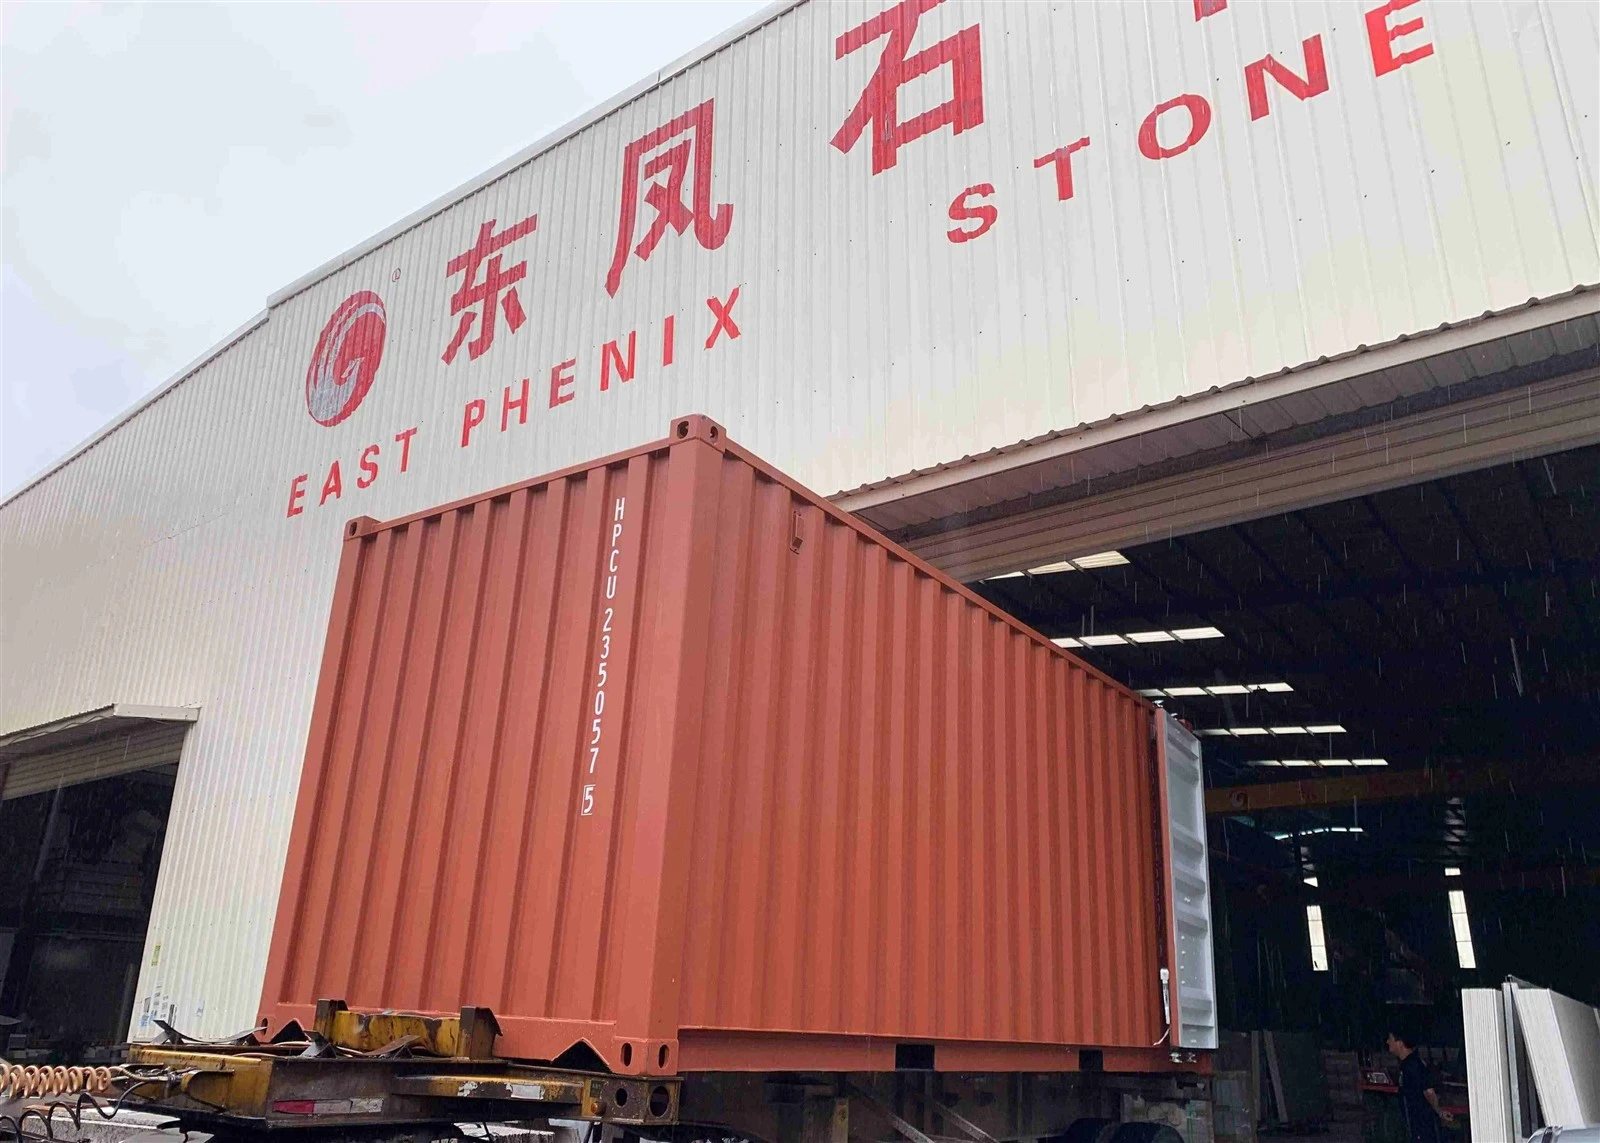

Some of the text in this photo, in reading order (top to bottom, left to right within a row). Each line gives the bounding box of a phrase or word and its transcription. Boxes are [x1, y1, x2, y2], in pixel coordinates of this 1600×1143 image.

[286, 0, 1435, 518] EAST PHENIX STONE
[441, 0, 1228, 364] 东凤石
[605, 497, 626, 600] HPCU
[589, 608, 614, 774] 235057
